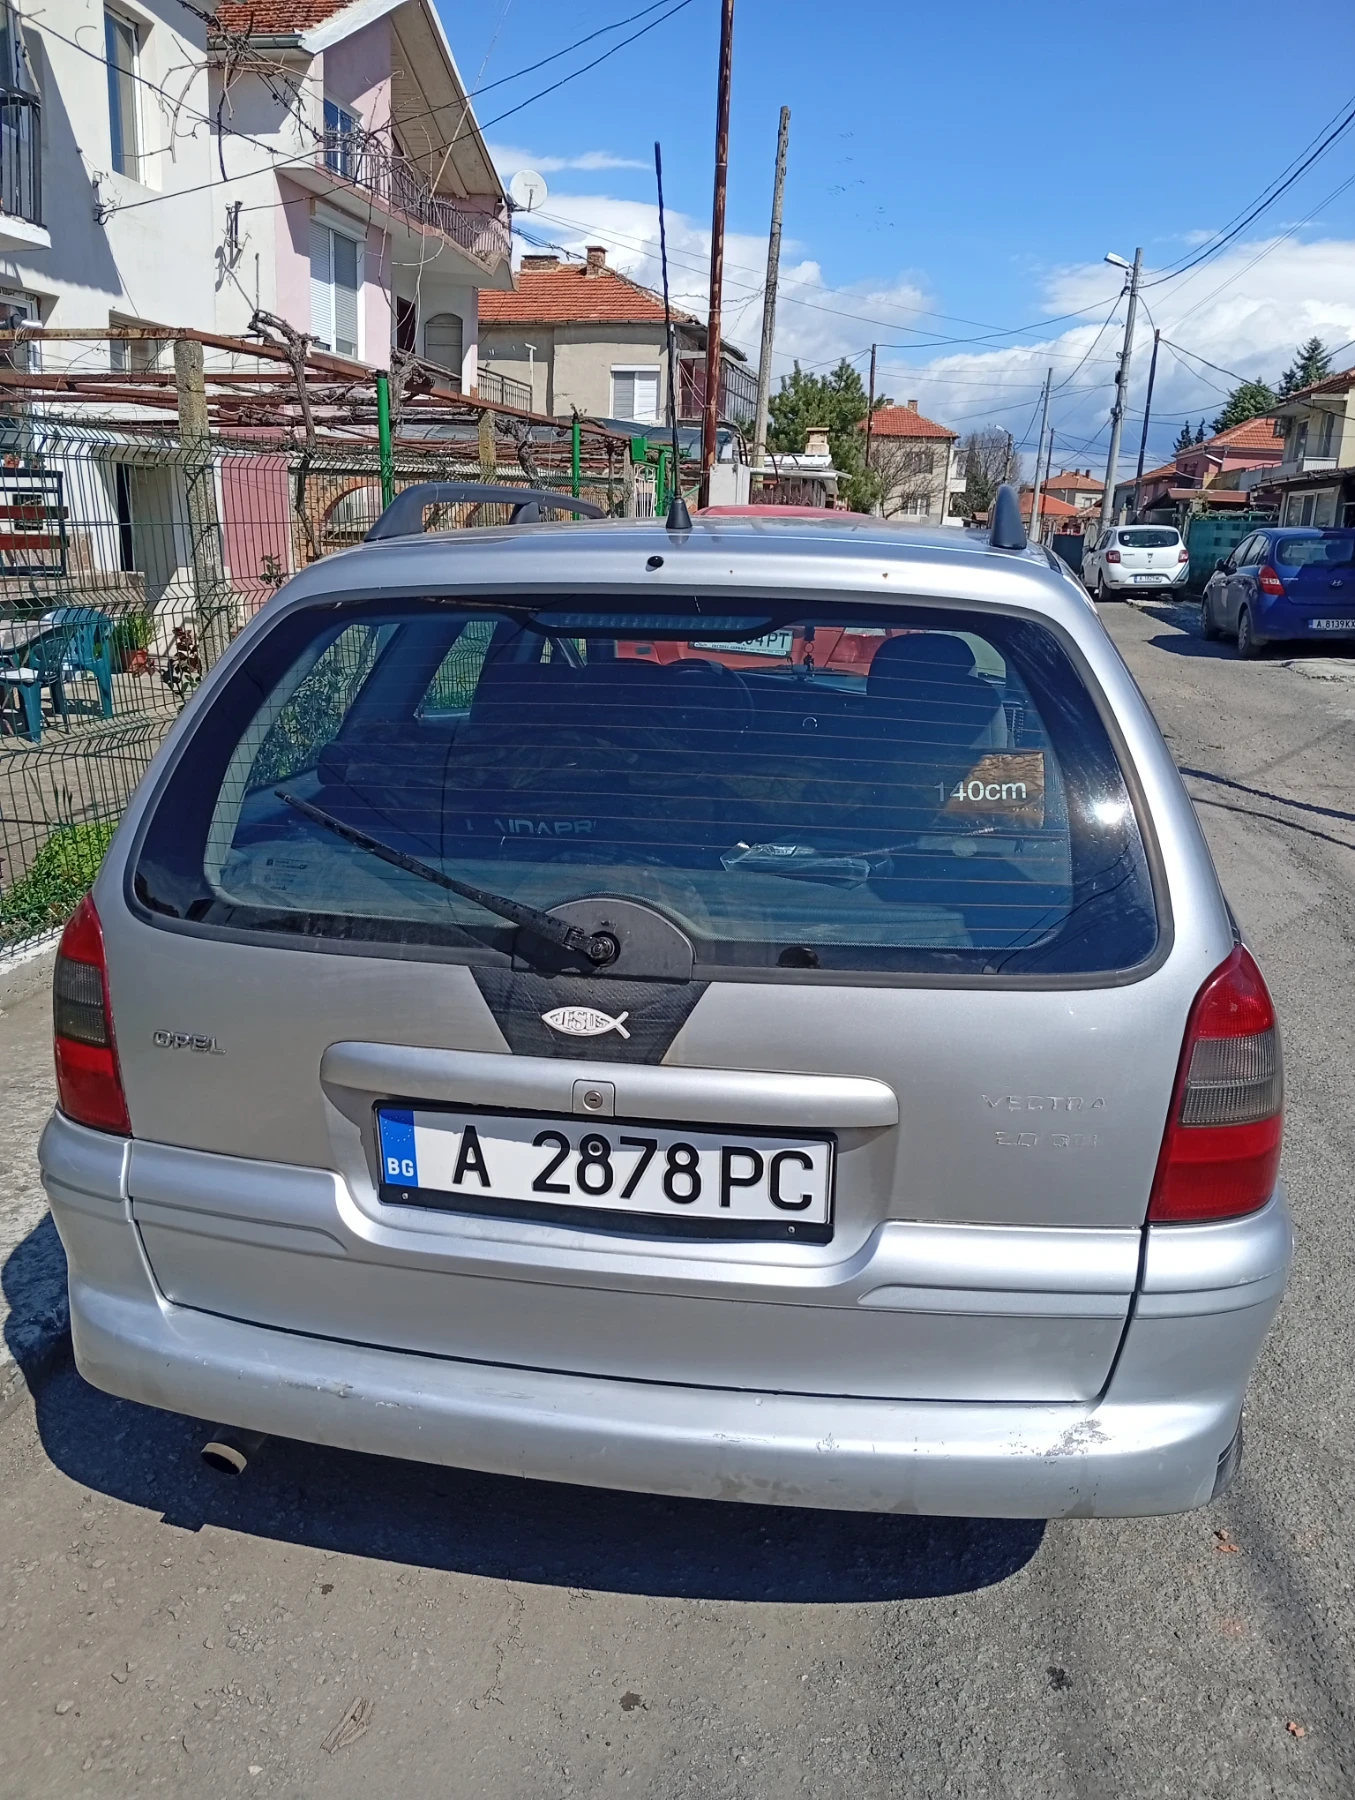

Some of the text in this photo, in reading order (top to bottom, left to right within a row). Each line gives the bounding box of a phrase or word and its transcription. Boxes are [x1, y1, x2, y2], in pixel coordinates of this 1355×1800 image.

[934, 780, 1027, 801] 140cm
[153, 1029, 227, 1055] OPEL
[981, 1094, 1108, 1113] VECTRA
[387, 1157, 415, 1177] BG
[452, 1124, 814, 1211] A 2878 PC
